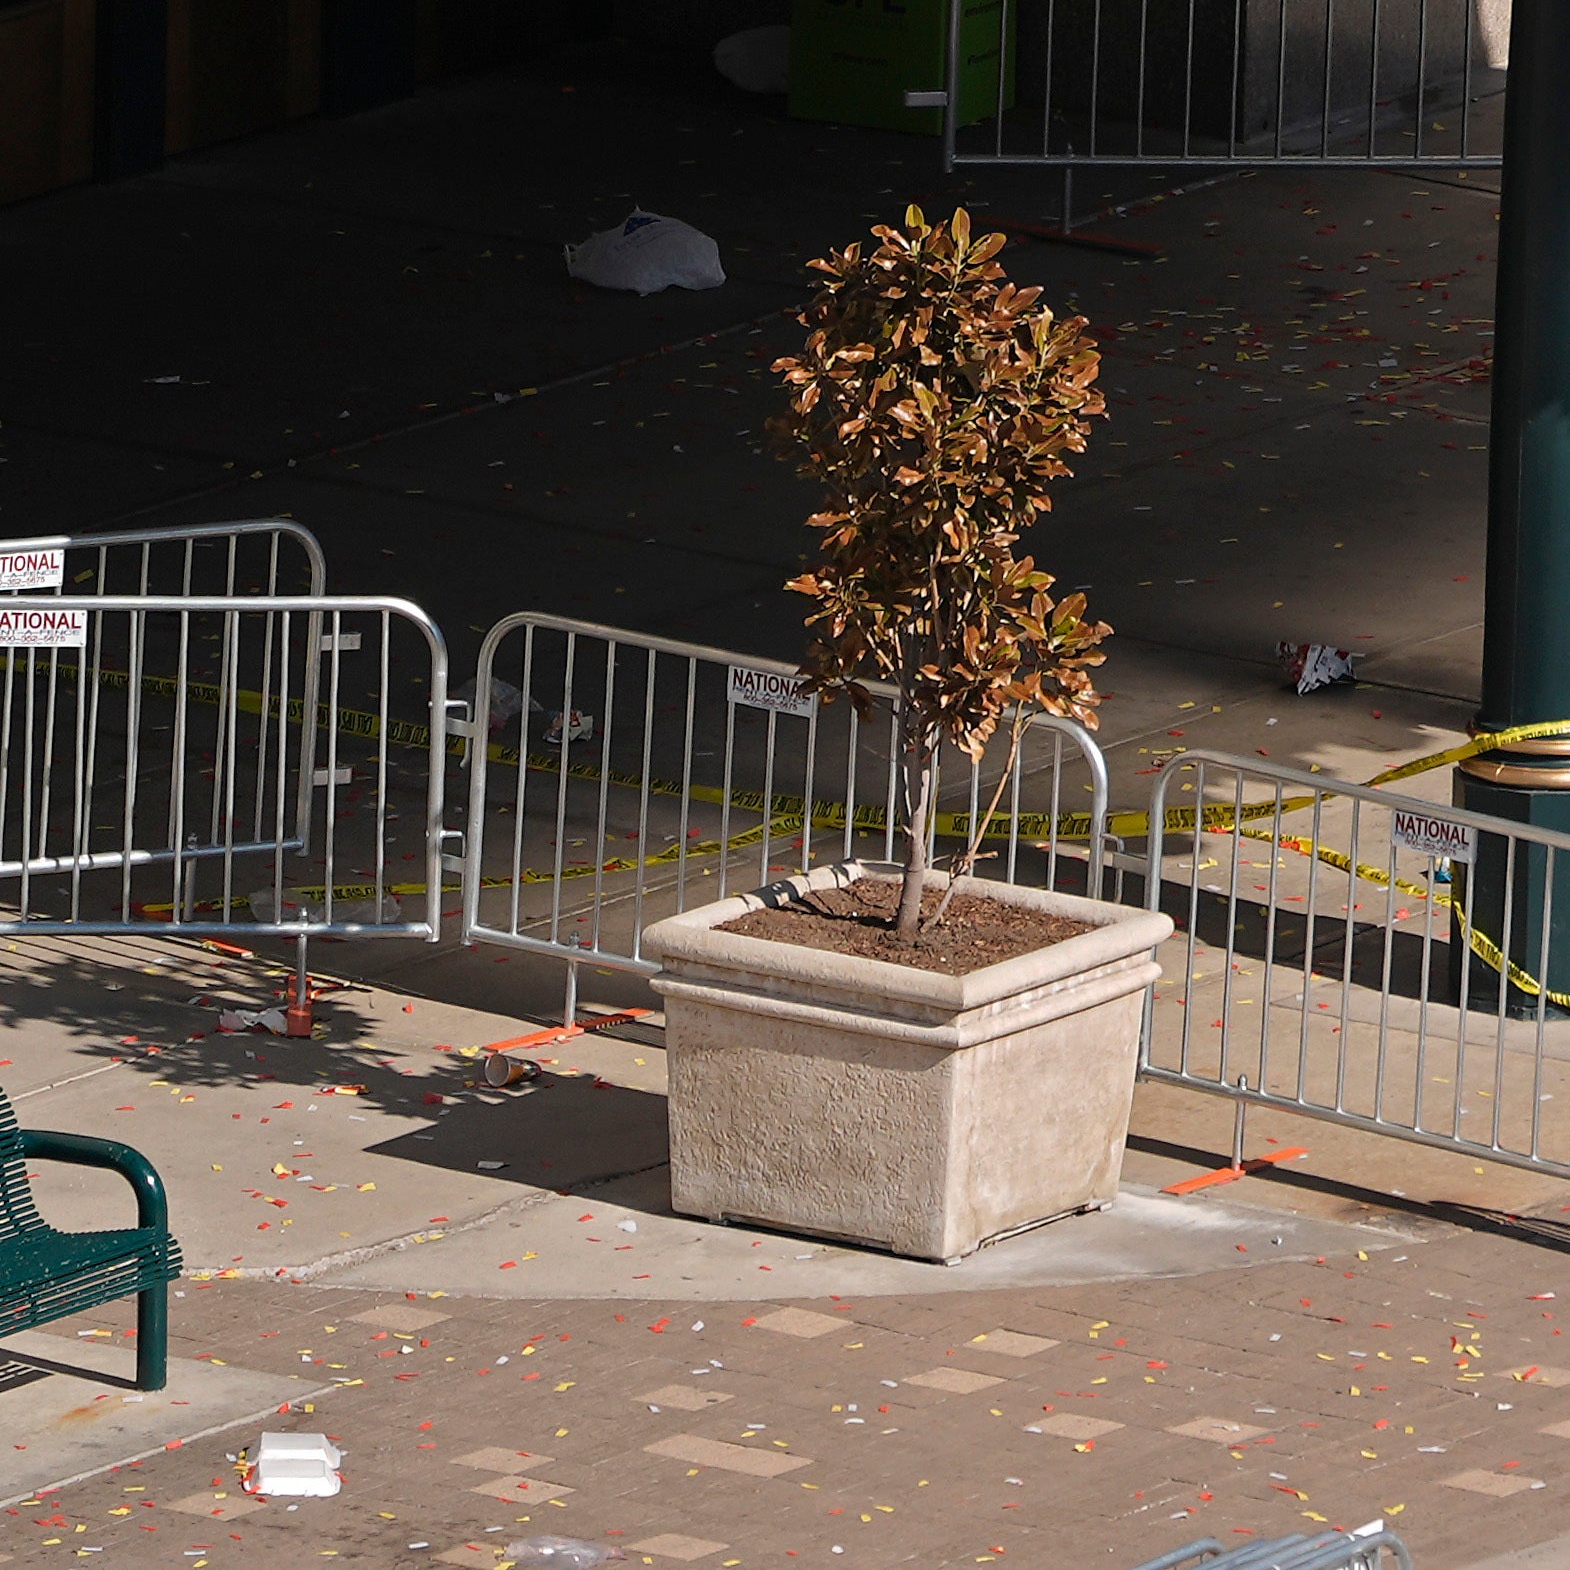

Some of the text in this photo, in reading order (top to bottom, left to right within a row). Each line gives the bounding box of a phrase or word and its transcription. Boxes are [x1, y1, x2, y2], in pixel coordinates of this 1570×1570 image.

[0, 552, 60, 573] TIONAL
[0, 612, 82, 630] ATIONAL
[733, 668, 811, 702] NATIONA
[1395, 812, 1470, 846] NATIONAL
